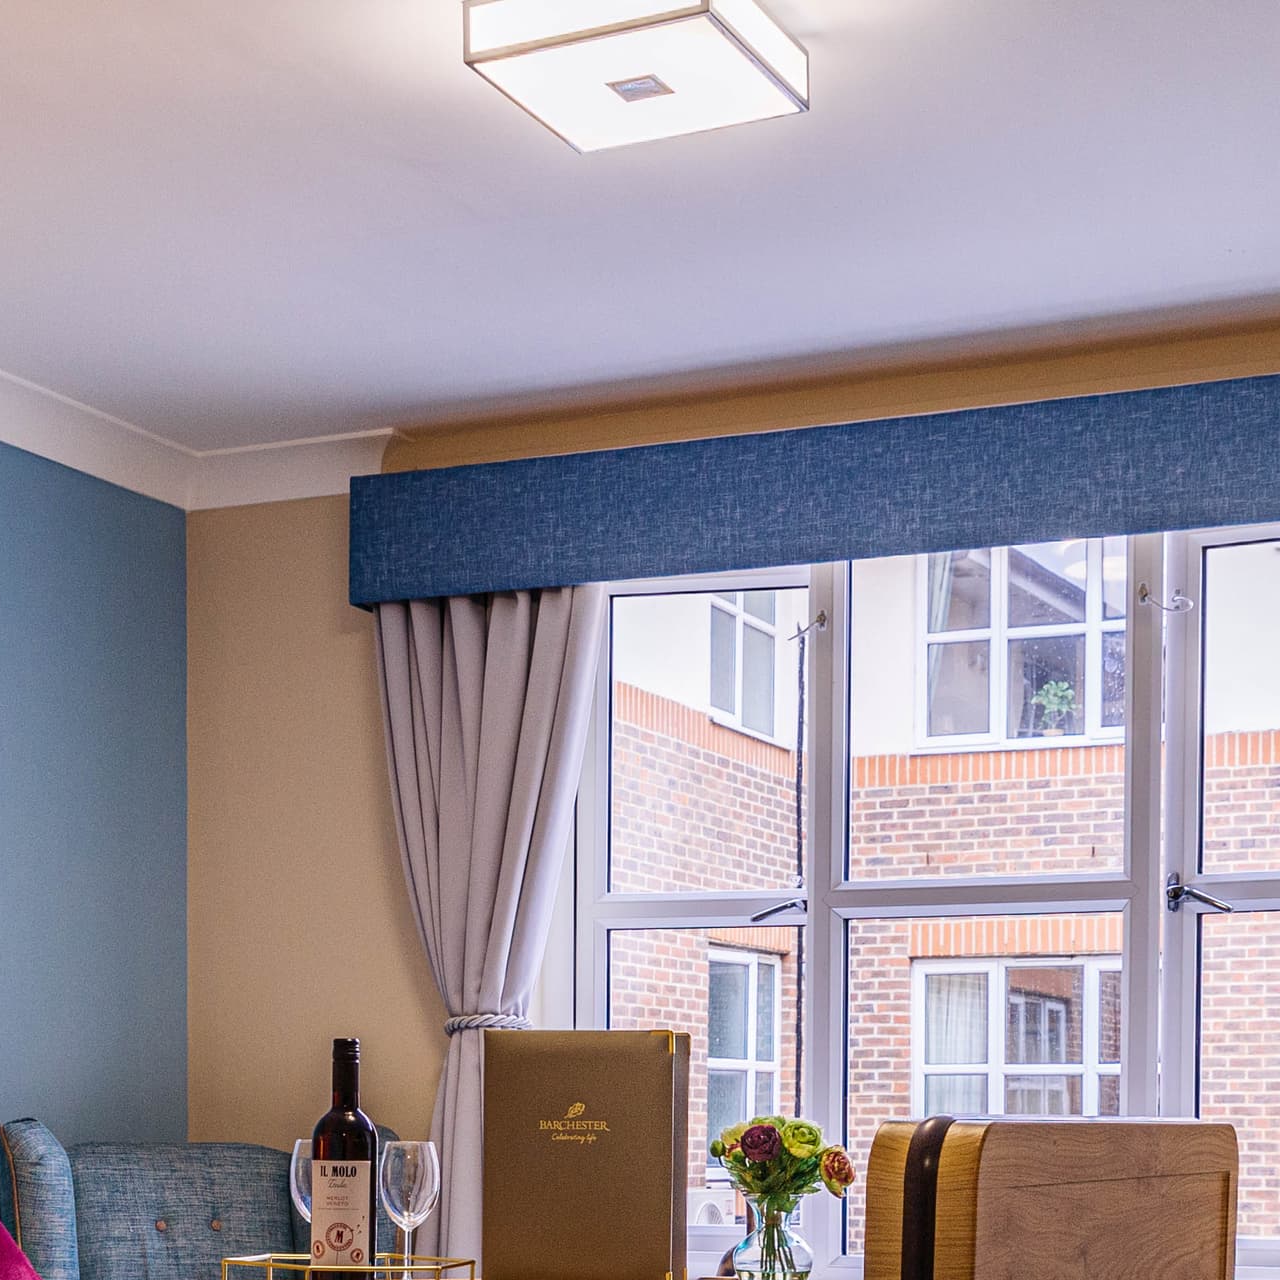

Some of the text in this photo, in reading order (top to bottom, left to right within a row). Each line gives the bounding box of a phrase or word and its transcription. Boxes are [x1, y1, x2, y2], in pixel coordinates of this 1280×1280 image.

[540, 1120, 610, 1131] BARCHESTER
[320, 1165, 357, 1177] IL MOLO
